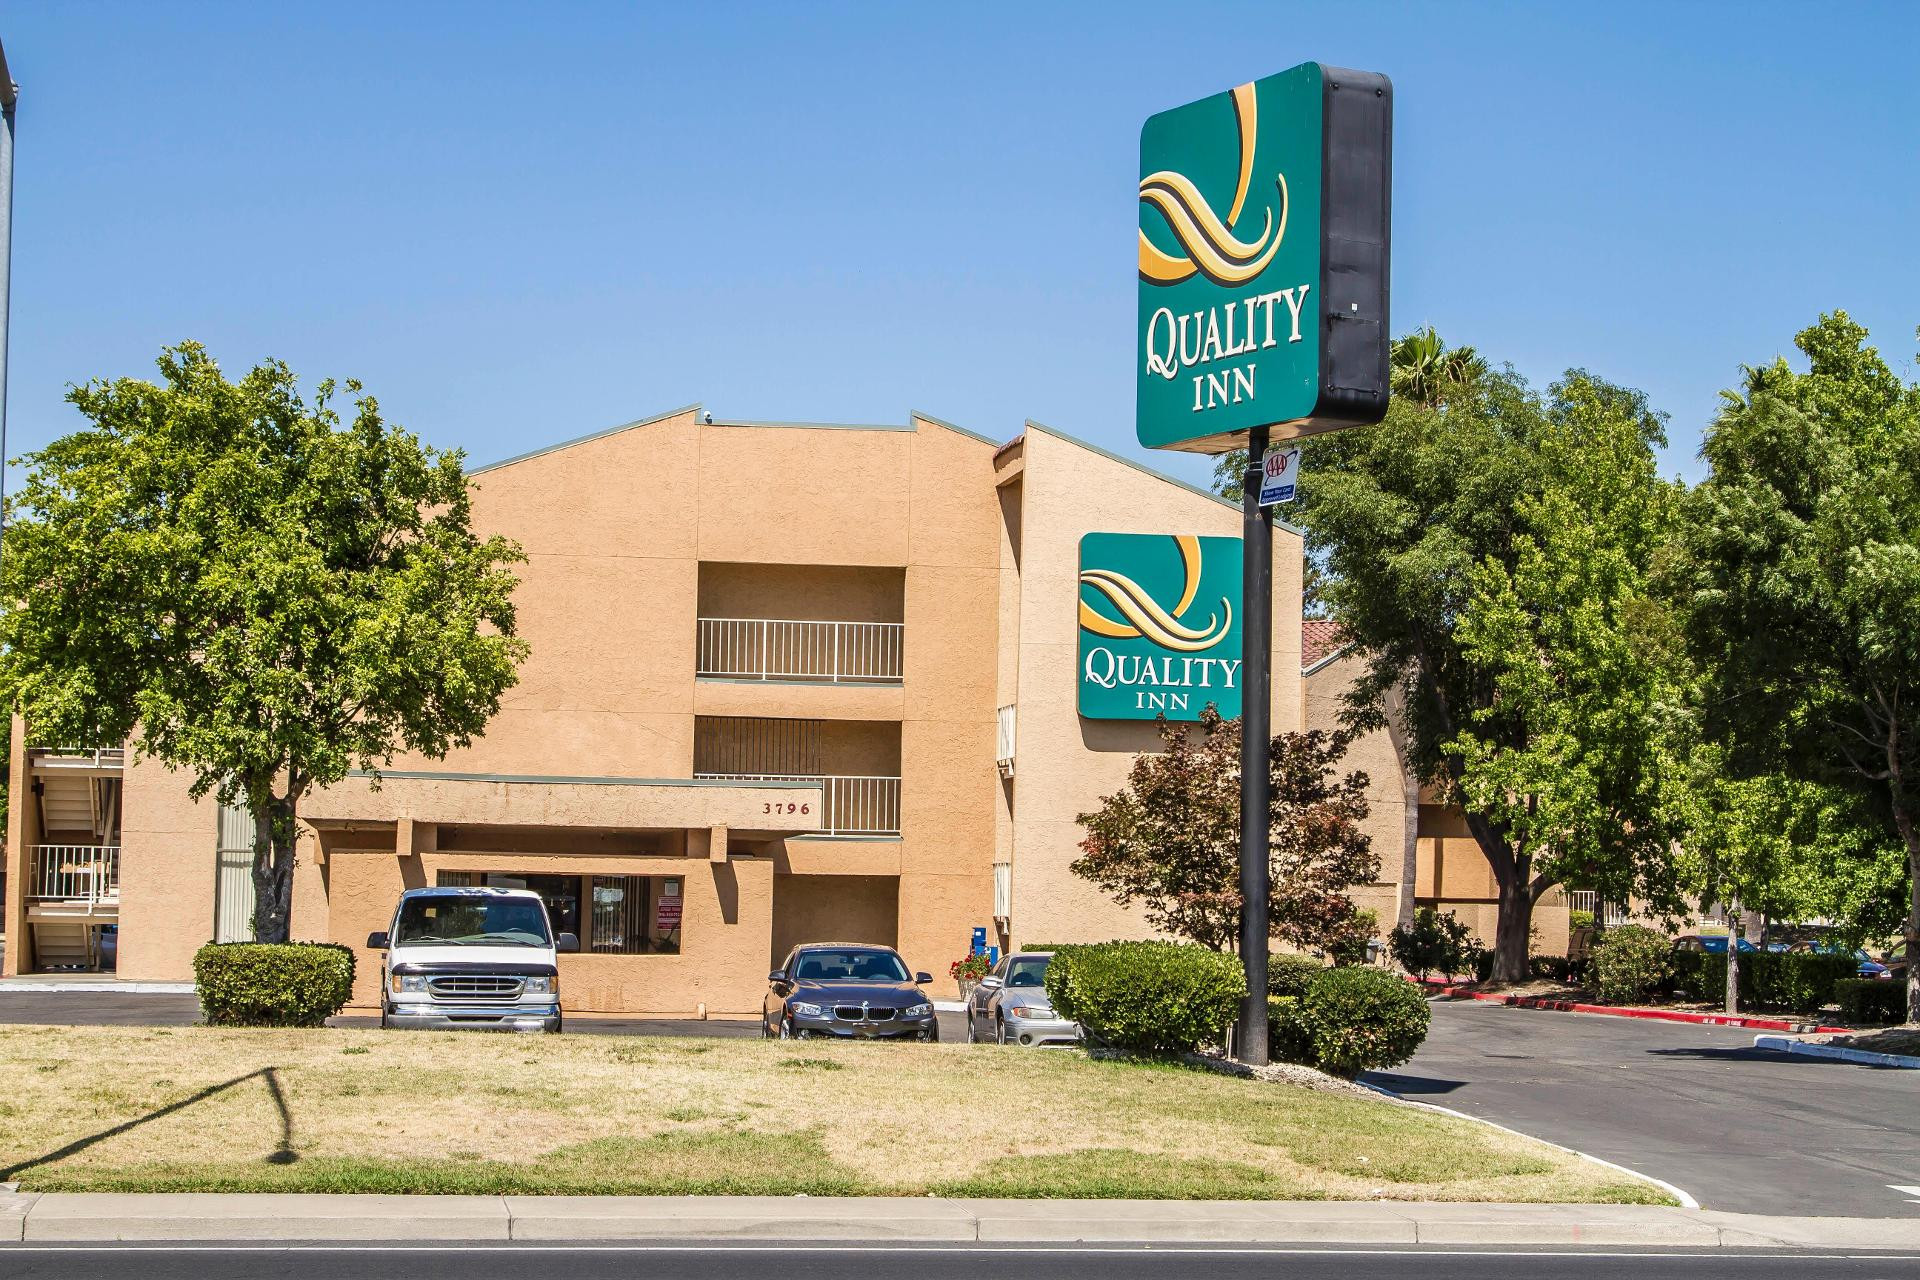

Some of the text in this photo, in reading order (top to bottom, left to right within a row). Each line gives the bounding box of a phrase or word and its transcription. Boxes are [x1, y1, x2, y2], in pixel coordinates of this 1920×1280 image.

[1146, 284, 1310, 379] QUALITY
[1192, 363, 1257, 412] INN
[1085, 647, 1242, 689] QUALITY
[1136, 692, 1189, 711] INN
[762, 803, 810, 815] 3796
